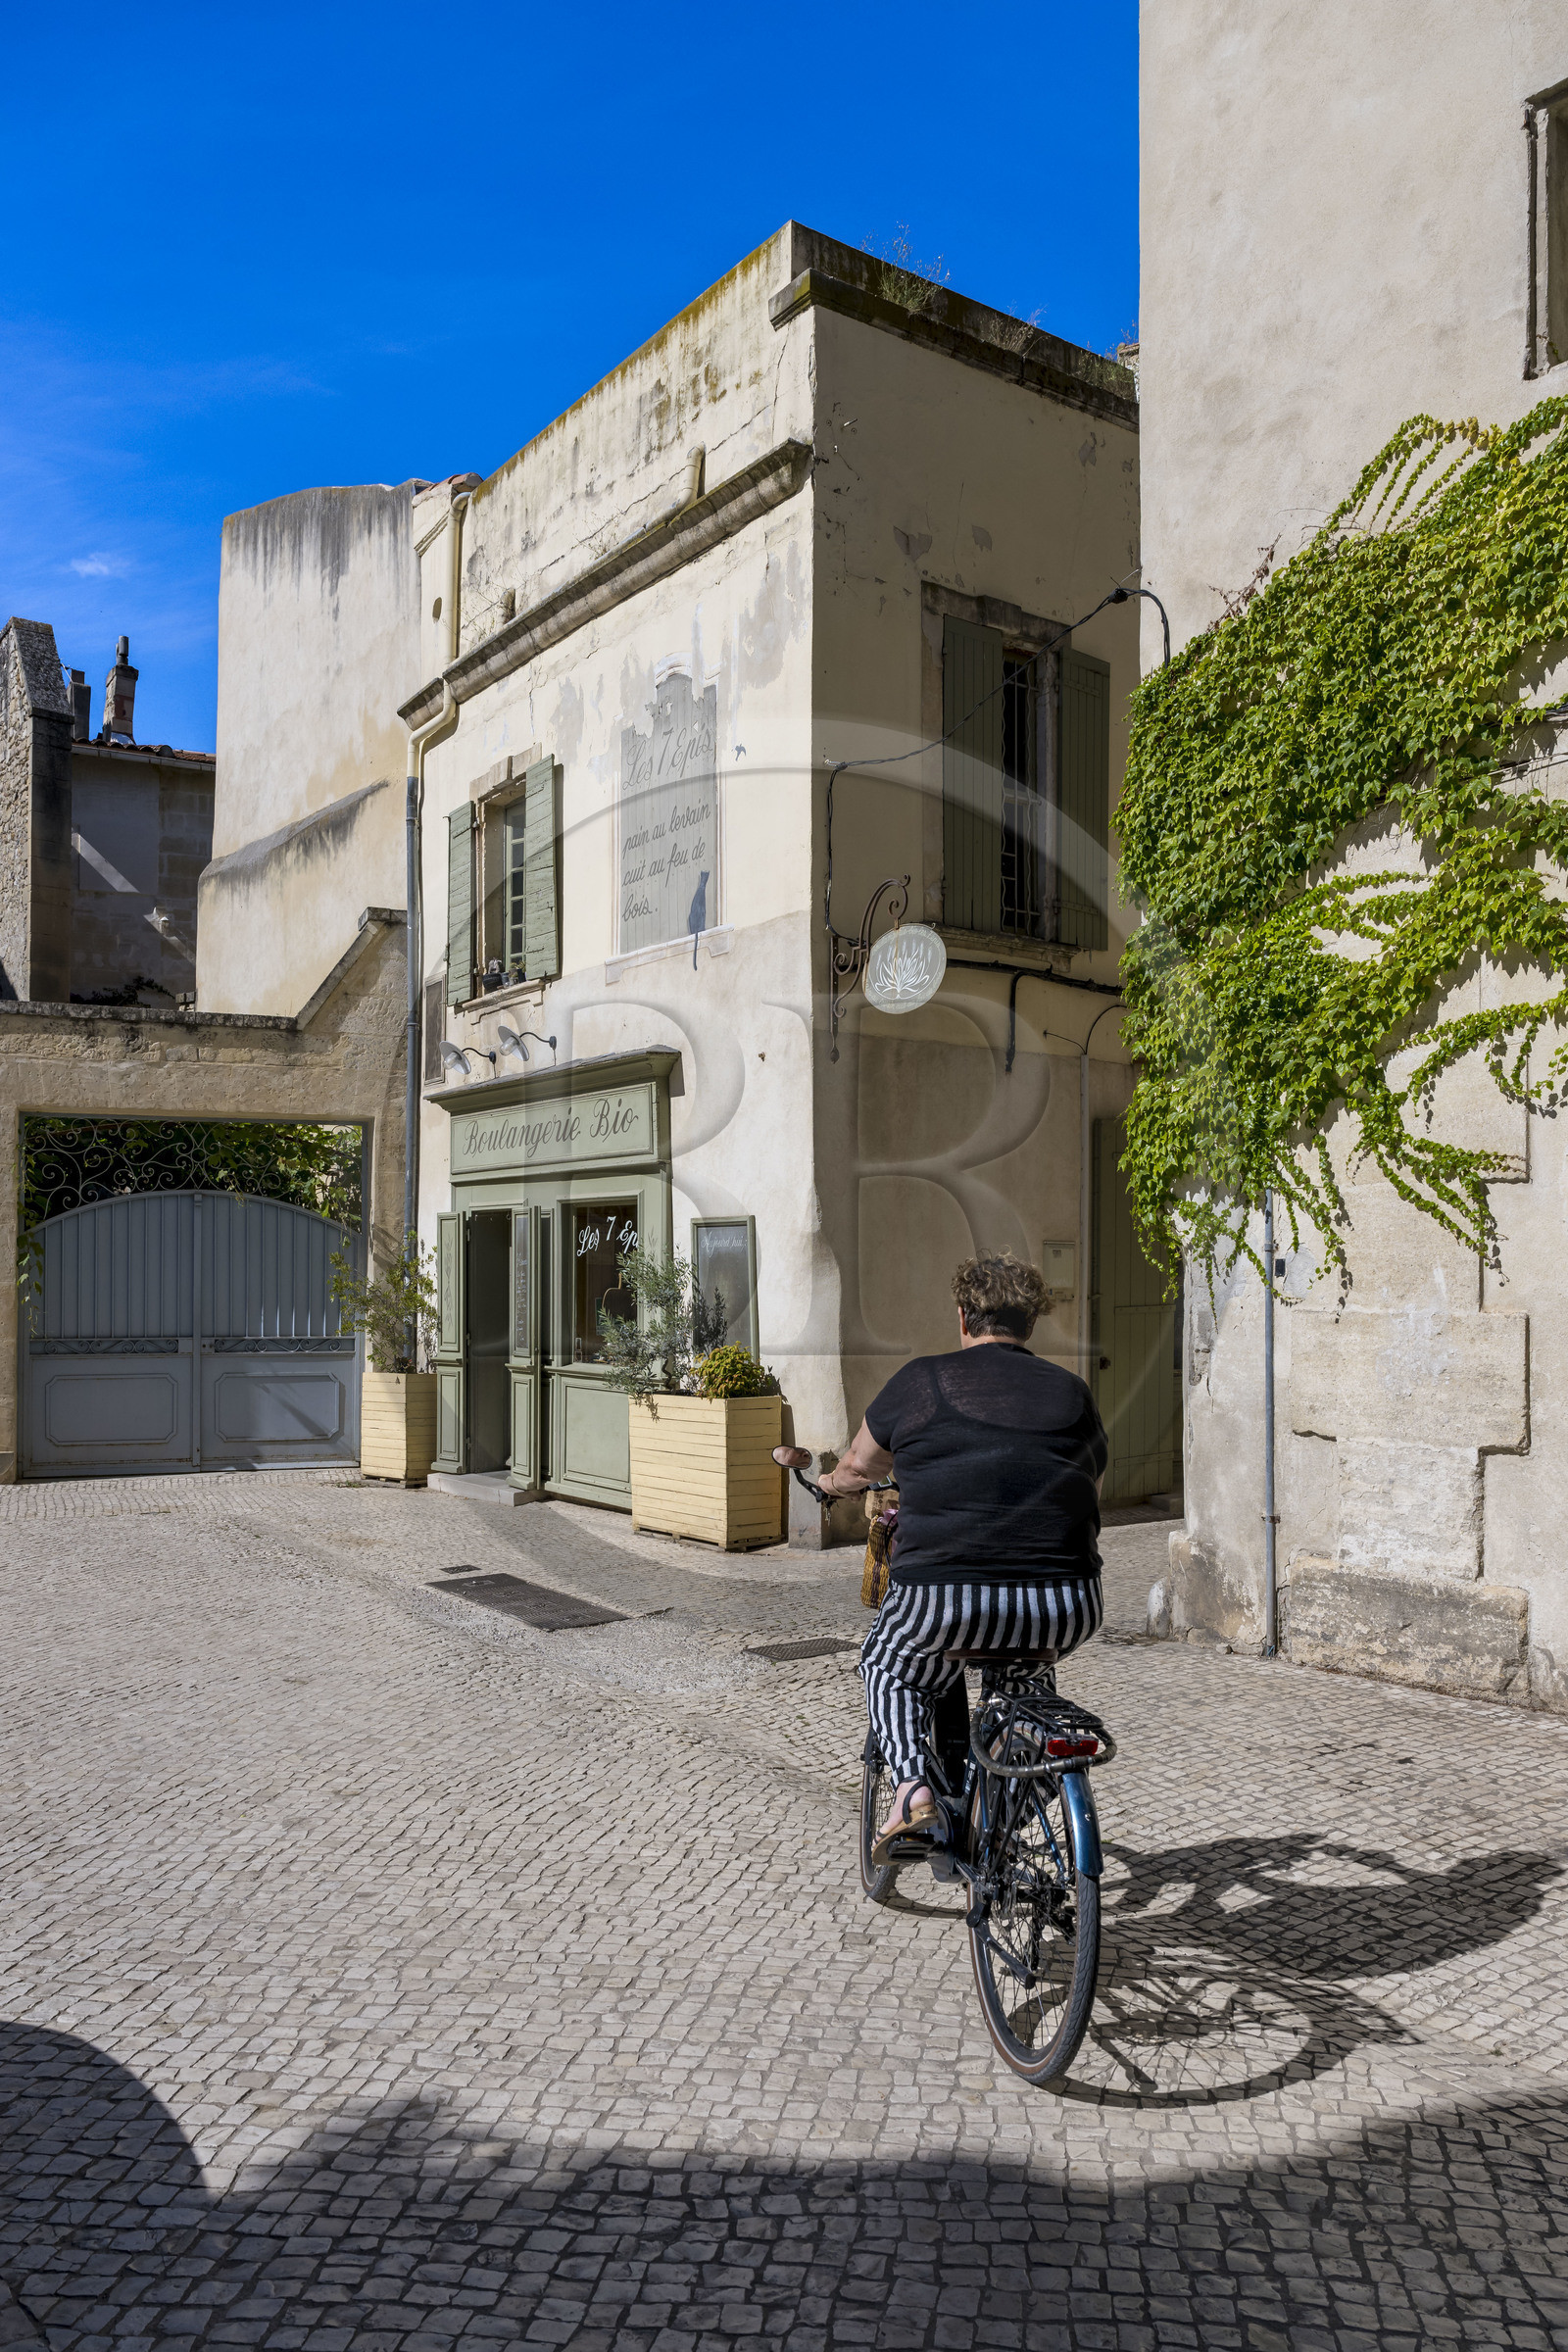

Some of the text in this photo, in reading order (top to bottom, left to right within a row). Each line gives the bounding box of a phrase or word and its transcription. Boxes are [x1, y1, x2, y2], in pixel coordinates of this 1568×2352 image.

[622, 722, 713, 791] Les 7 Epis
[622, 799, 710, 859] pain au levain
[621, 836, 706, 889] cuit au feu de
[621, 893, 659, 923] bois.
[462, 1098, 639, 1158] Boulangerie Bio
[576, 1215, 638, 1257] Les 7 Ep
